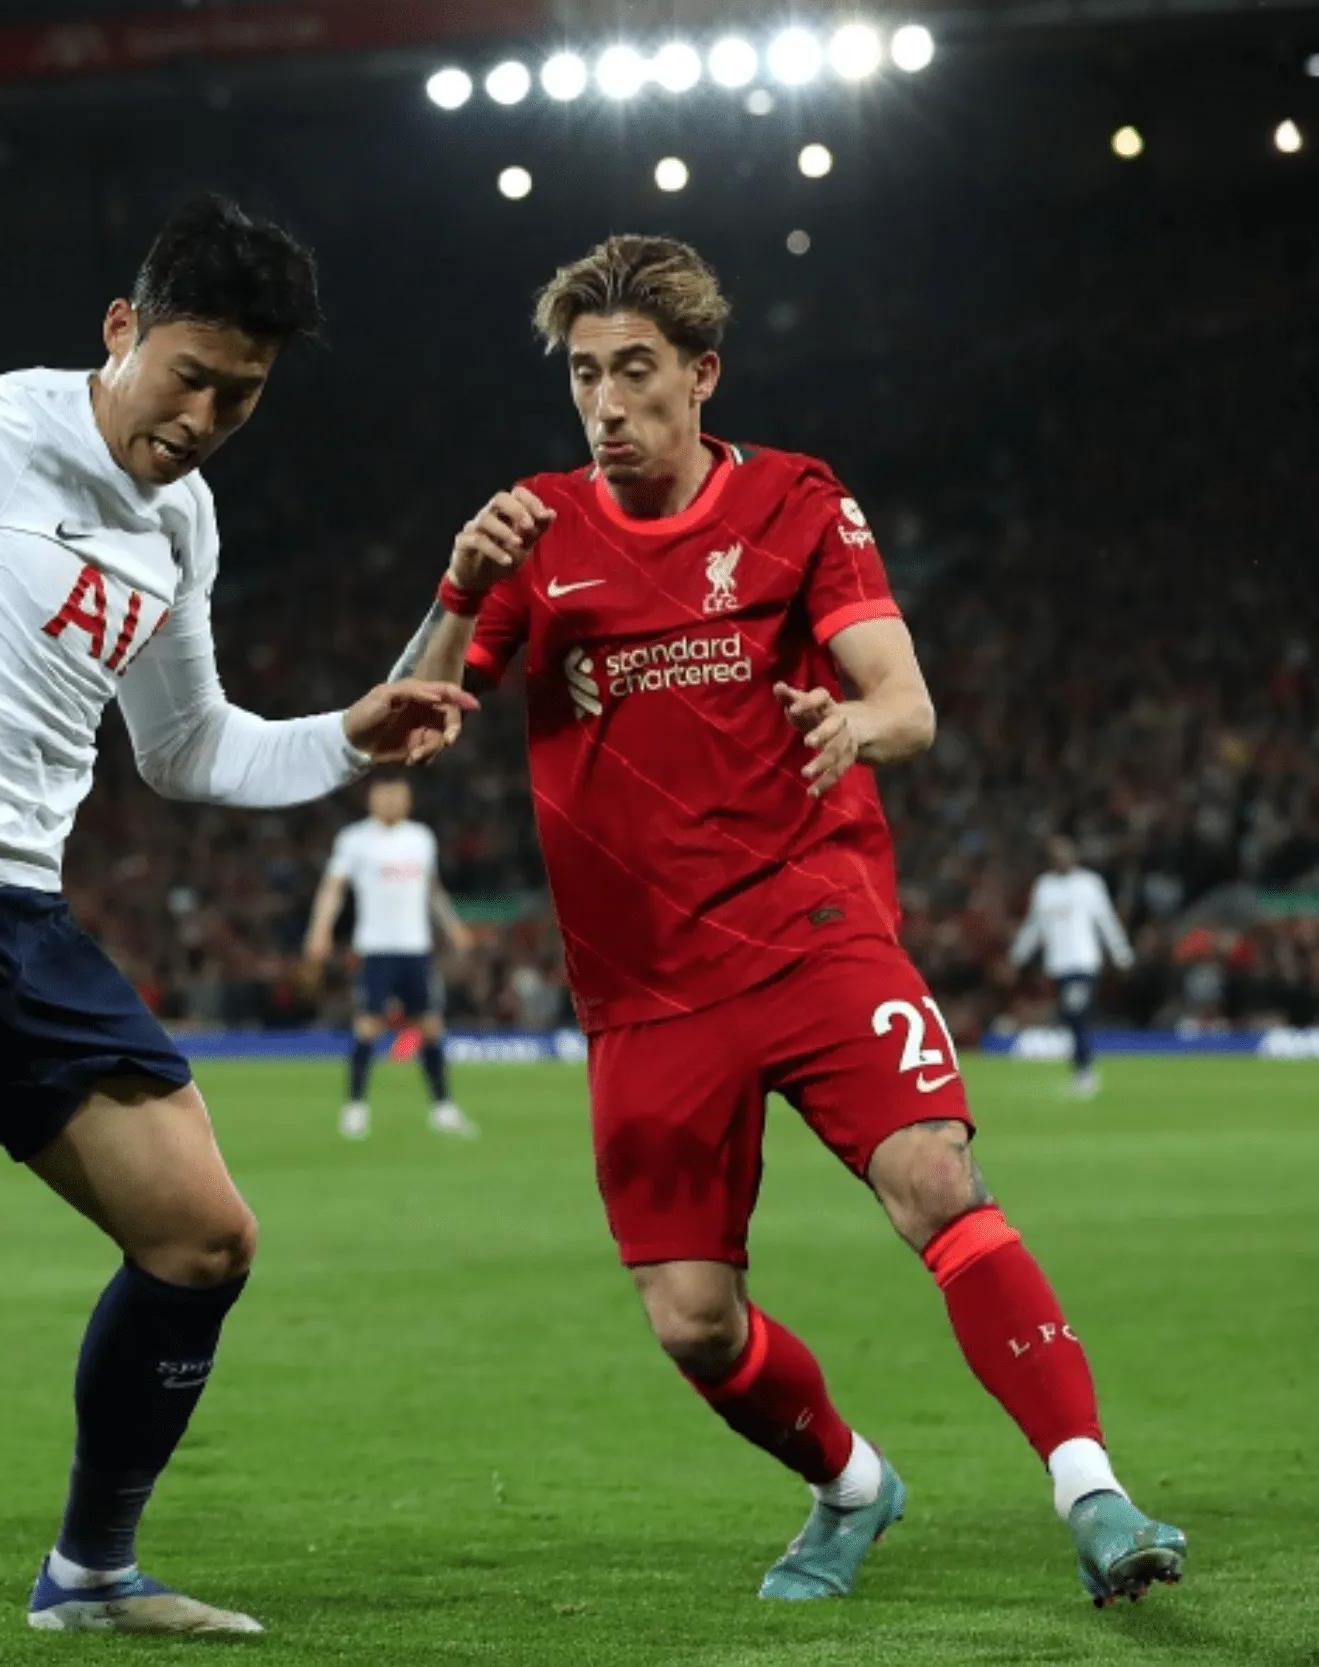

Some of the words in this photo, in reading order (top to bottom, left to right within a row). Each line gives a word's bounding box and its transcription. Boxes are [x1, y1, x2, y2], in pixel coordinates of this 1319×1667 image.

[41, 562, 172, 677] AI
[703, 593, 739, 613] LFC
[606, 633, 740, 676] standard
[609, 657, 751, 697] chartered
[871, 996, 959, 1072] 21
